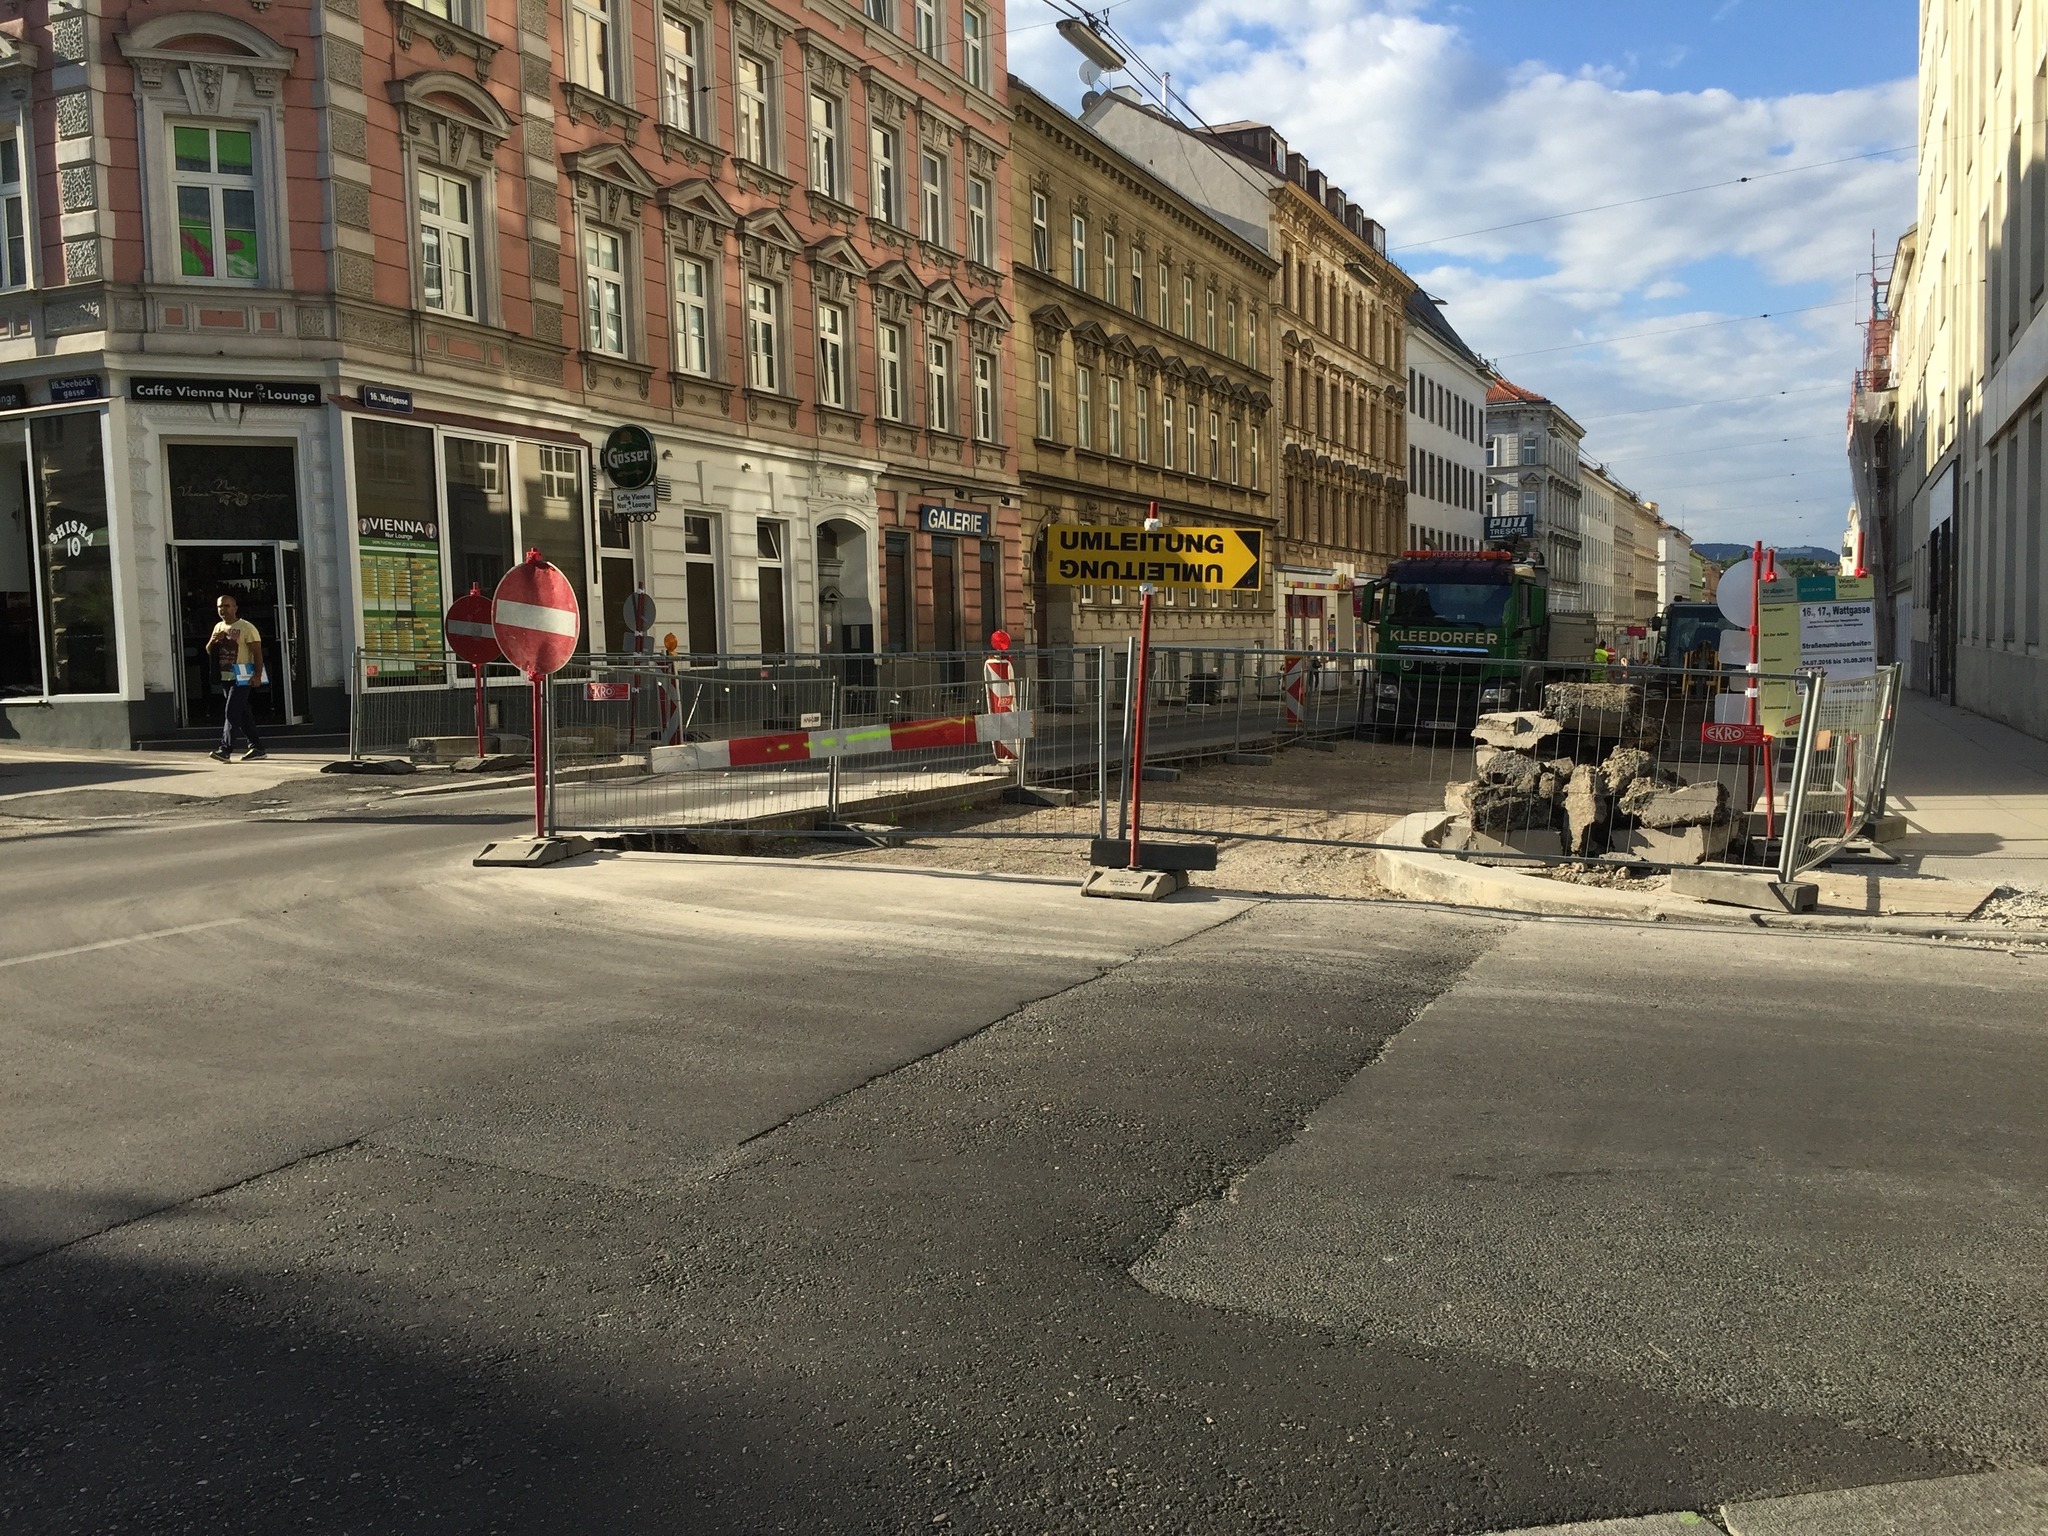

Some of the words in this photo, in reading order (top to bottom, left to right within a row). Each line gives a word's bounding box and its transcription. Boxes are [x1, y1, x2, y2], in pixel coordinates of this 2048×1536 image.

[63, 388, 85, 399] gasse
[136, 384, 173, 397] Caffe
[176, 386, 224, 398] Vienna
[228, 388, 254, 399] Nur
[267, 389, 316, 404] Lounge
[607, 447, 650, 469] Gösser
[369, 517, 425, 534] VIENNA
[928, 508, 982, 533] GALERIE
[48, 519, 94, 547] SHISHA
[395, 533, 413, 541] Lounge
[67, 536, 81, 558] 10
[1060, 531, 1224, 554] UMLEITUNG
[1059, 559, 1223, 583] UMLEITUNG
[1832, 605, 1871, 617] Wattgasse
[1389, 629, 1498, 645] KLEEDORFER
[1802, 640, 1872, 650] Straßenumbauarbeiten
[1706, 725, 1742, 740] EKRO
